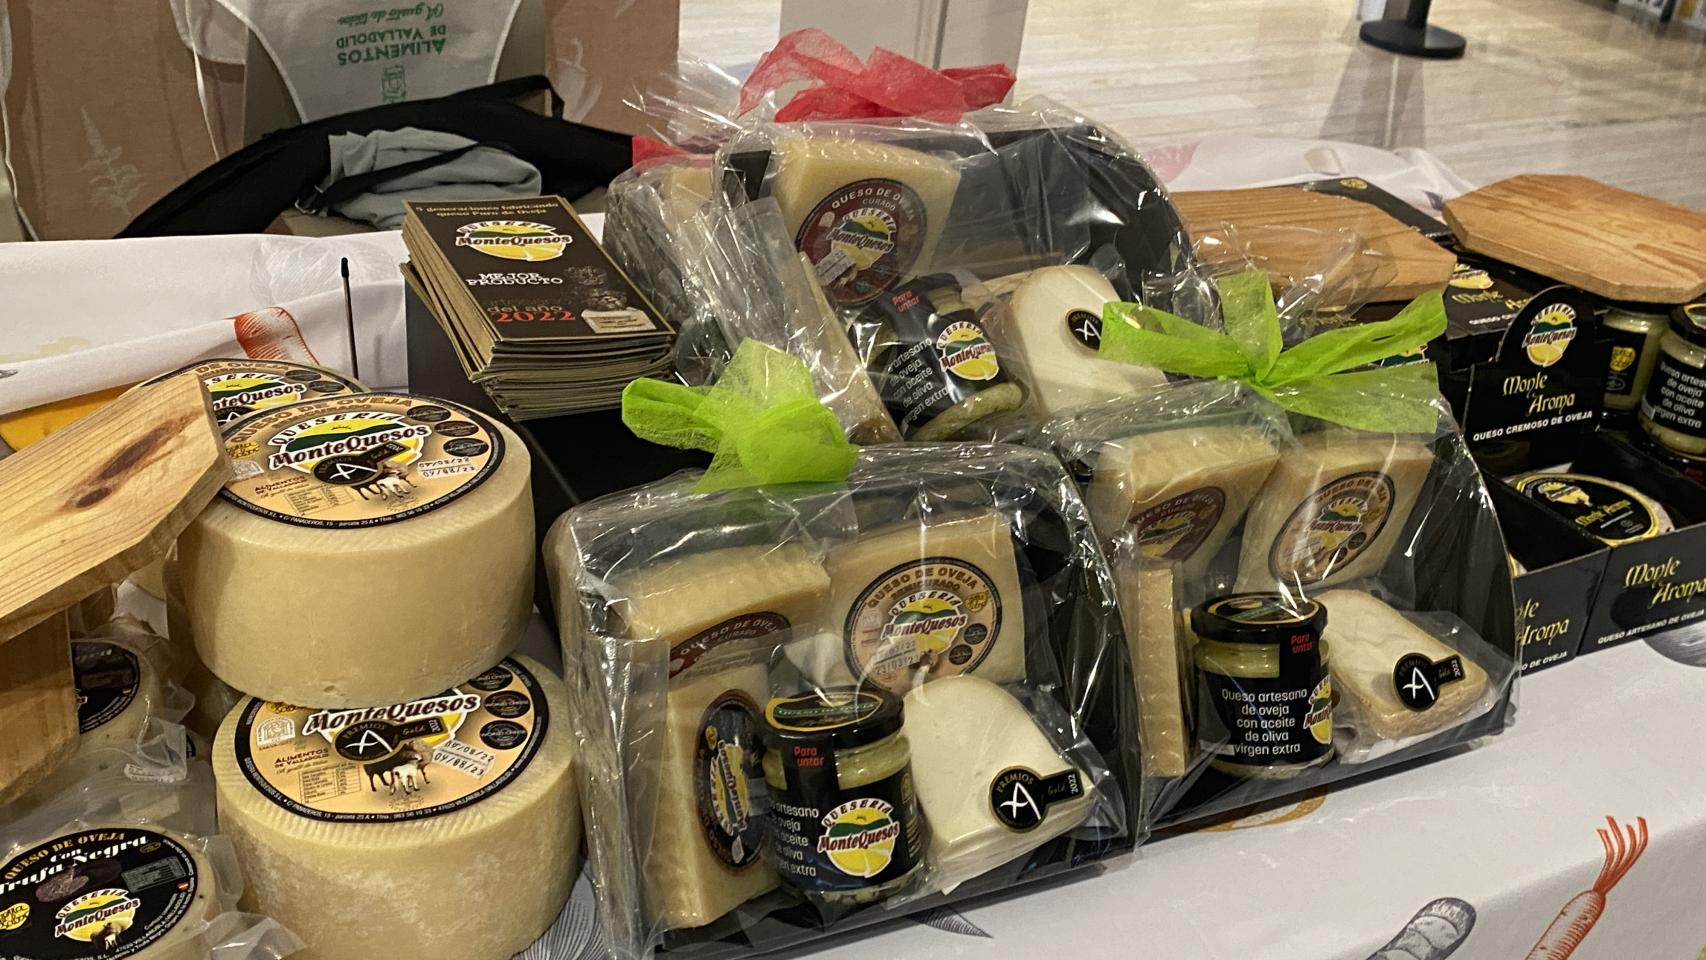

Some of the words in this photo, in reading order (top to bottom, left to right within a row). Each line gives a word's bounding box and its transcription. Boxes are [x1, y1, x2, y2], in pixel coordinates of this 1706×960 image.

[336, 28, 423, 48] VALLADOLID
[430, 25, 446, 36] DE
[337, 38, 447, 66] ALIMENTOS
[832, 188, 873, 208] QUESO
[876, 188, 891, 197] DE
[863, 199, 895, 211] CURADO
[459, 235, 571, 247] MonteQuesos
[831, 228, 893, 251] MonteQuesos
[465, 277, 563, 286] PRODUCTO
[892, 290, 912, 305] Para
[497, 310, 576, 322] 2022
[196, 364, 220, 372] DE
[212, 373, 284, 383] SERIA
[900, 358, 923, 378] oveja
[906, 367, 934, 390] aceite
[1503, 372, 1548, 398] Monte
[1667, 379, 1677, 388] de
[1678, 384, 1702, 397] oveja
[1681, 374, 1706, 388] artes
[213, 384, 304, 409] nteQuesos
[912, 381, 934, 399] oliva
[925, 387, 950, 408] extra
[1661, 386, 1675, 398] con
[1676, 394, 1704, 408] aceite
[1526, 393, 1575, 417] Aroma
[1662, 398, 1673, 408] de
[1674, 404, 1695, 416] oliva
[230, 411, 292, 443] QUESO
[298, 403, 327, 413] DE
[337, 397, 413, 406] OVEJA
[272, 412, 401, 445] QUESERIA
[1473, 428, 1503, 441] QUESO
[1506, 419, 1548, 435] CREMOSO
[1551, 416, 1563, 425] DE
[1565, 411, 1593, 423] OVEJA
[1678, 415, 1702, 428] extra
[273, 425, 428, 468] MonteQuesos
[1624, 557, 1680, 588] Monte
[868, 573, 910, 608] QUESO
[915, 568, 934, 578] DE
[938, 567, 978, 590] OVEJA
[1647, 578, 1706, 609] Aroma
[891, 591, 962, 616] QUESERIA
[883, 616, 967, 639] MonteQuesos
[1598, 631, 1625, 644] QUESO
[1626, 620, 1667, 637] ARTESANO
[1668, 616, 1680, 625] DE
[1681, 609, 1705, 621] OVEJA
[1530, 659, 1541, 668] DE
[1543, 651, 1568, 664] OVEJA
[1222, 688, 1255, 701] Queso
[1258, 688, 1308, 701] artesano
[306, 695, 478, 734] MonteQuesos
[1242, 705, 1256, 715] de
[1258, 704, 1289, 717] oveja
[1237, 718, 1257, 728] con
[1261, 717, 1296, 729] aceite
[1245, 731, 1259, 742] de
[1262, 731, 1289, 742] oliva
[274, 747, 329, 764] ALIMENTOS
[287, 753, 330, 767] VALLADOLID
[794, 746, 817, 757] Para
[1234, 743, 1270, 757] virgen
[1272, 743, 1301, 755] extra
[797, 756, 824, 767] untar
[996, 772, 1034, 792] PREMIOS
[1068, 774, 1079, 794] 2022
[776, 802, 819, 818] artesano
[823, 799, 892, 828] QUESERIA
[820, 824, 899, 851] MonteQuesos
[4, 849, 49, 880] QUESO
[52, 840, 74, 852] DE
[78, 832, 125, 844] OVEJA
[791, 862, 817, 876] extra
[58, 889, 127, 918] QUESERIA
[57, 899, 139, 937] MonteQuesos
